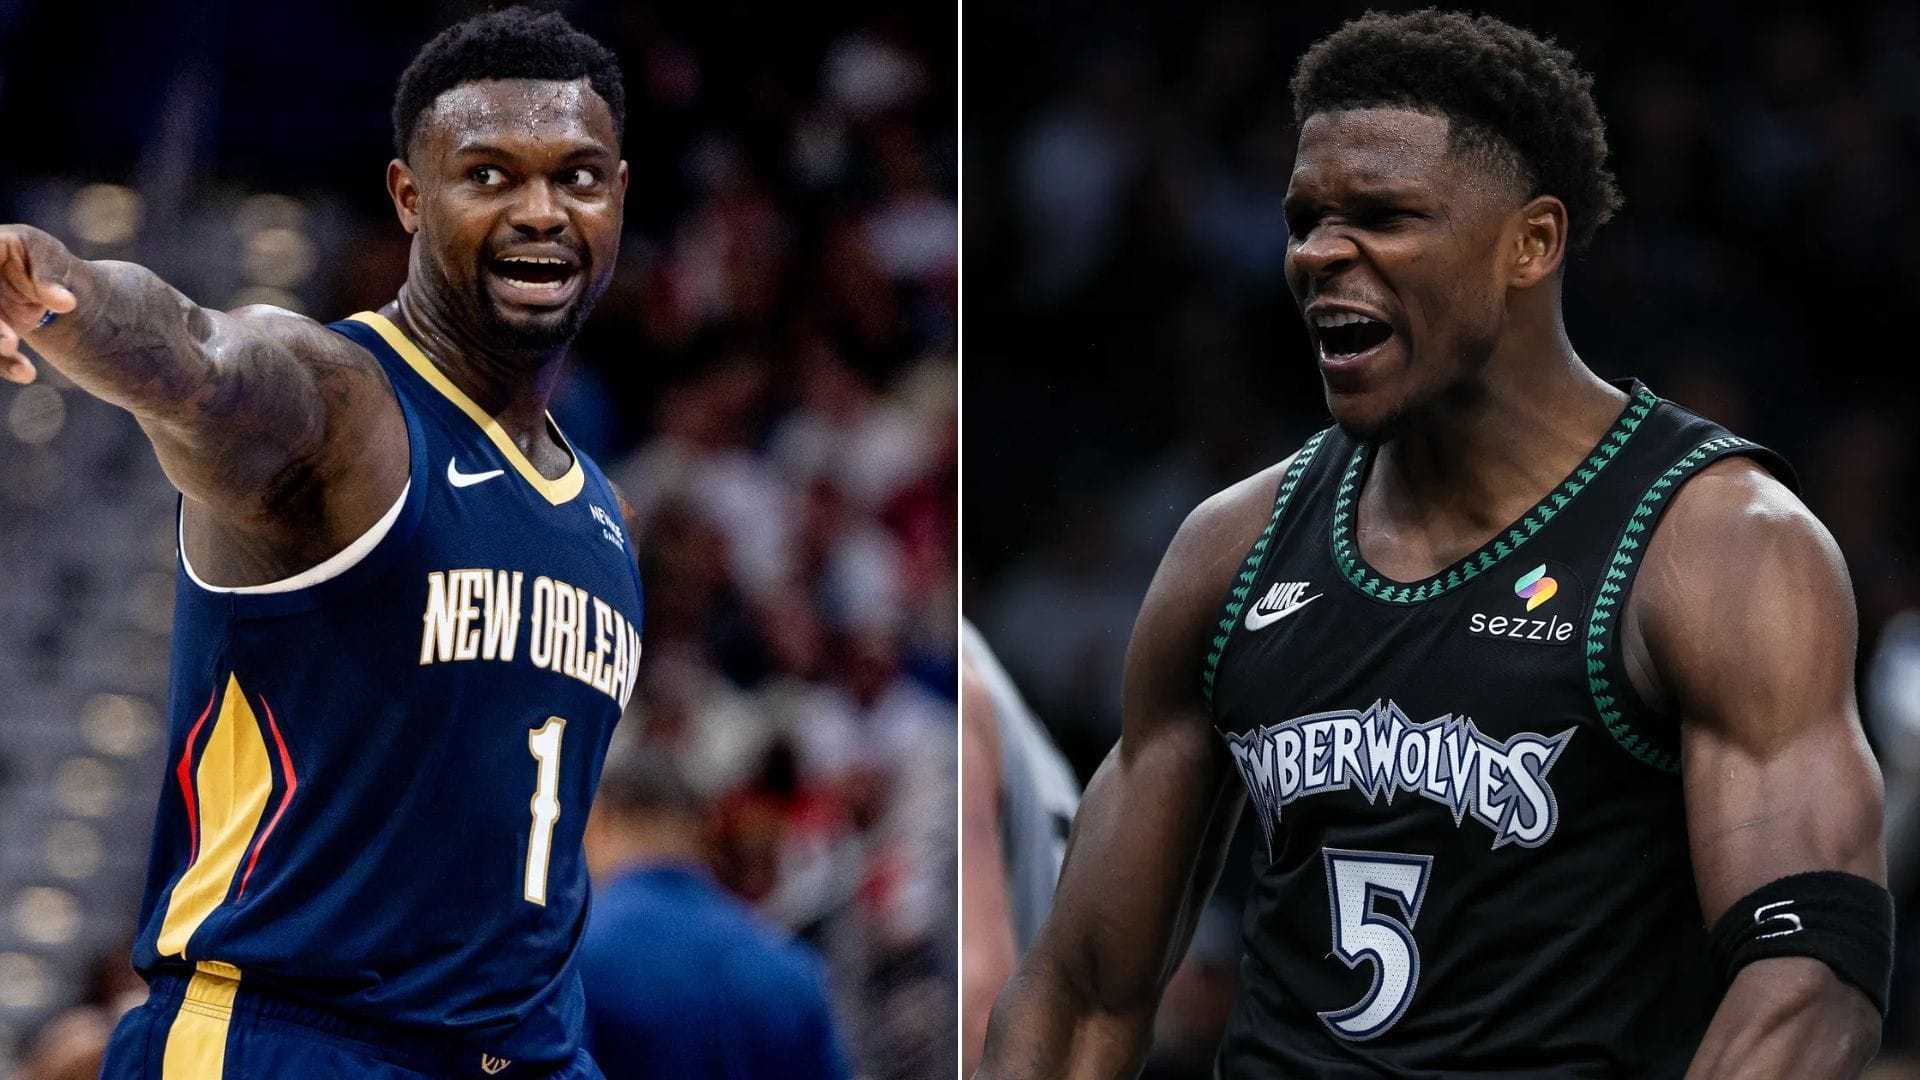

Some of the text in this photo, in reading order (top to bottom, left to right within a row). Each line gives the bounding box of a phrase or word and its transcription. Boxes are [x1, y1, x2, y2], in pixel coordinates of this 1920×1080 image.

[419, 568, 642, 713] NEW ORLEAN
[1258, 582, 1311, 610] NIKE
[1468, 613, 1574, 641] sezzle
[524, 715, 567, 906] 1
[1316, 847, 1434, 1042] 5
